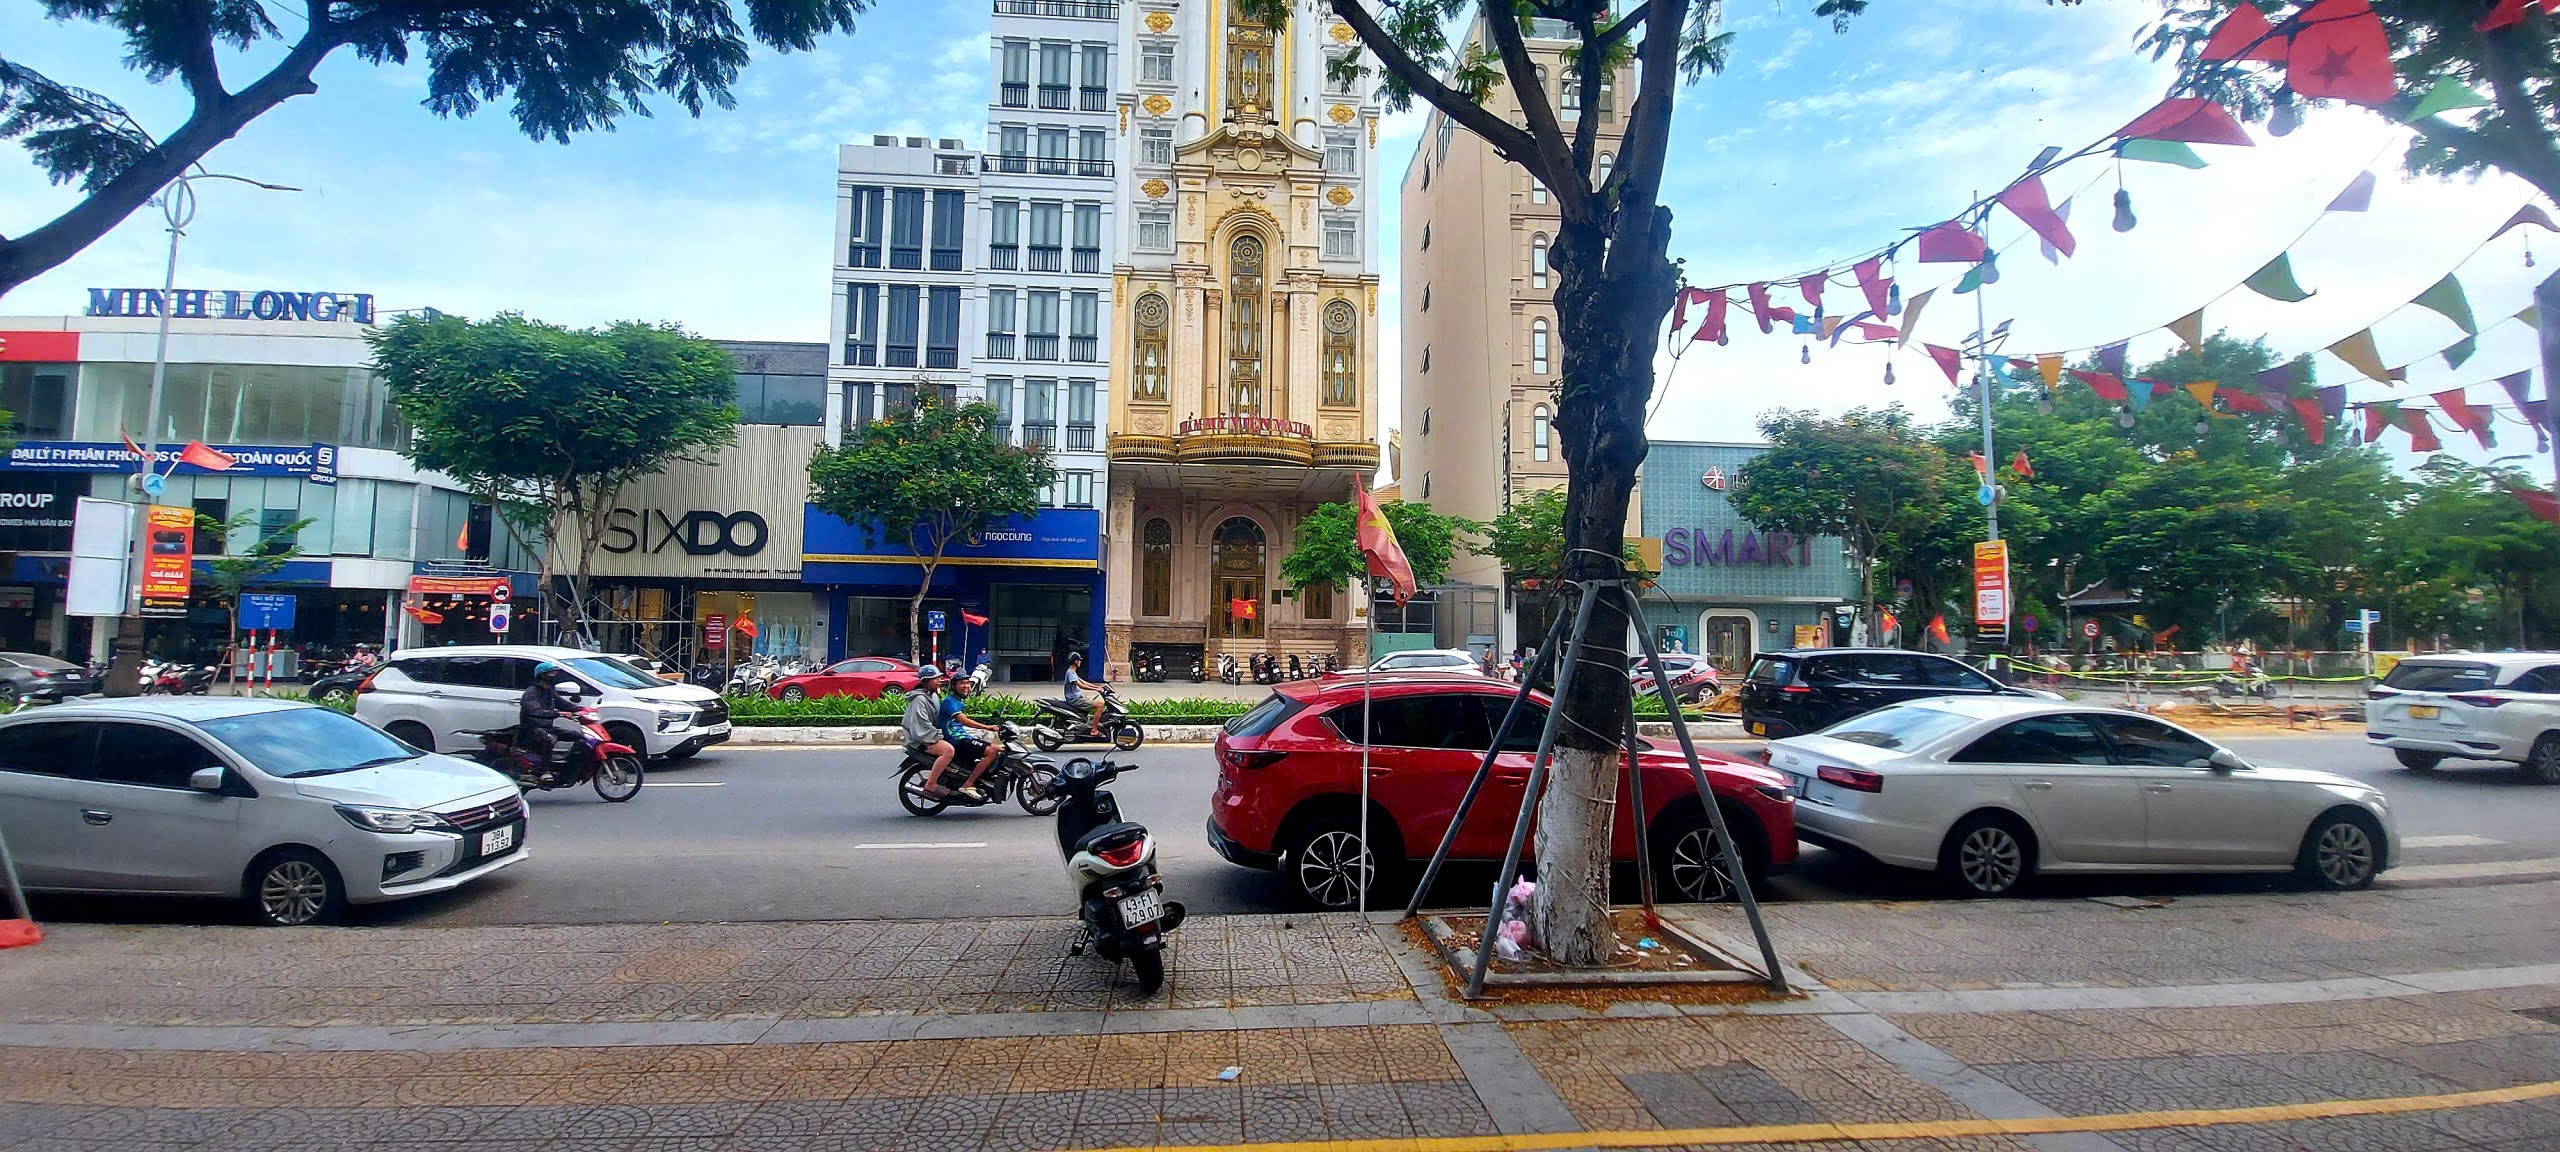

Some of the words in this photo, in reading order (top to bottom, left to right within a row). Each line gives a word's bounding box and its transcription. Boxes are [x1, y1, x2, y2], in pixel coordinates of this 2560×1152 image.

[88, 287, 209, 318] MINH
[222, 289, 339, 322] LONG
[11, 448, 35, 461] ĐẠI
[36, 446, 50, 460] LÝ
[68, 447, 101, 461] PHÂN
[601, 507, 769, 557] SIXDO
[1665, 527, 1814, 567] SMART
[1125, 893, 1153, 912] 43-F1
